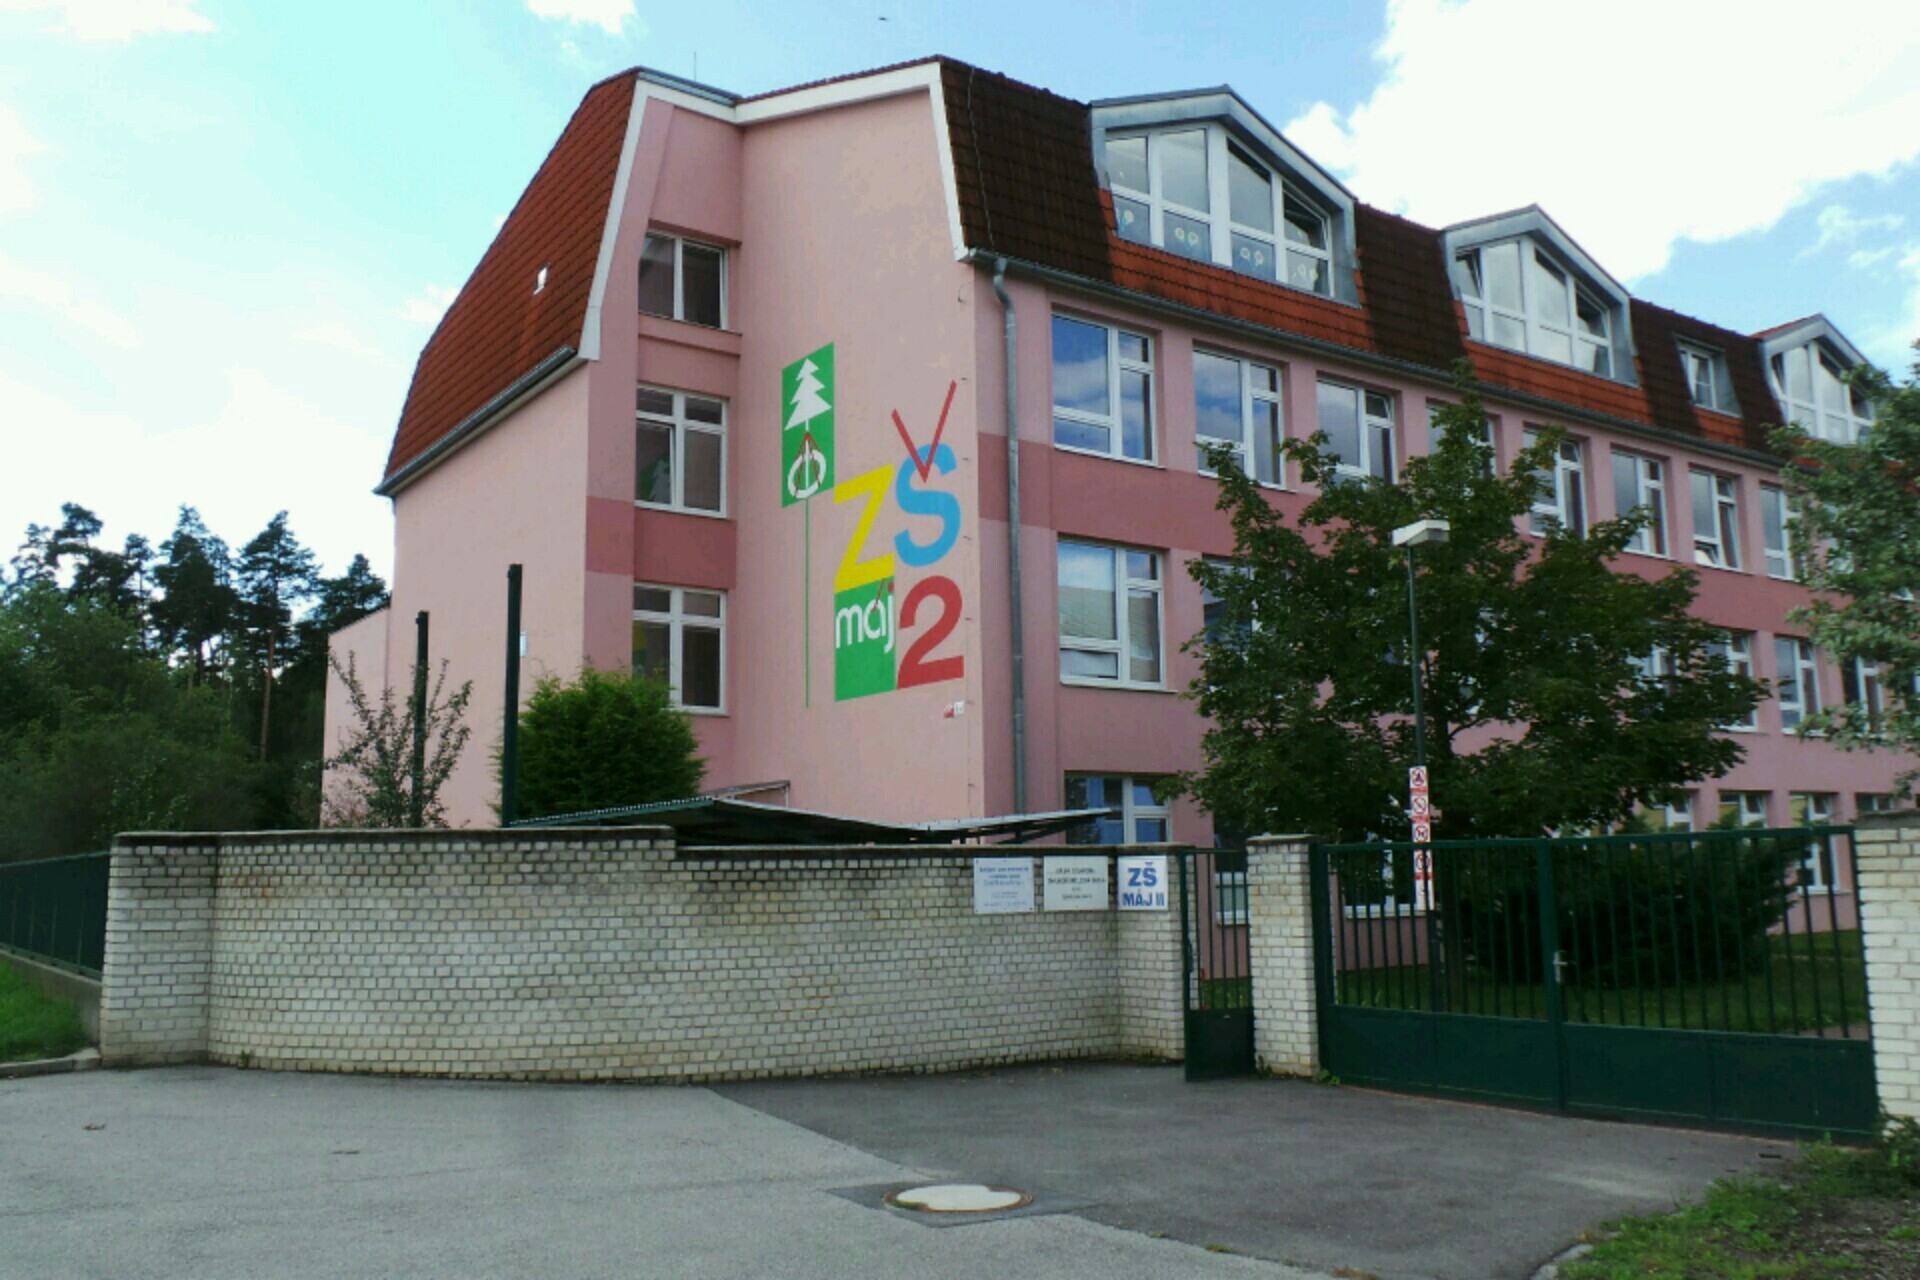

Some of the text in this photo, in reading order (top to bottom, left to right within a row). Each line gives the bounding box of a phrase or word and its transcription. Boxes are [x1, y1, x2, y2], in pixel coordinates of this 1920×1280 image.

[834, 380, 961, 593] ZŠ
[835, 576, 963, 689] máj 2
[1122, 889, 1165, 907] MÁJ II
[1127, 861, 1157, 887] ZŠ
